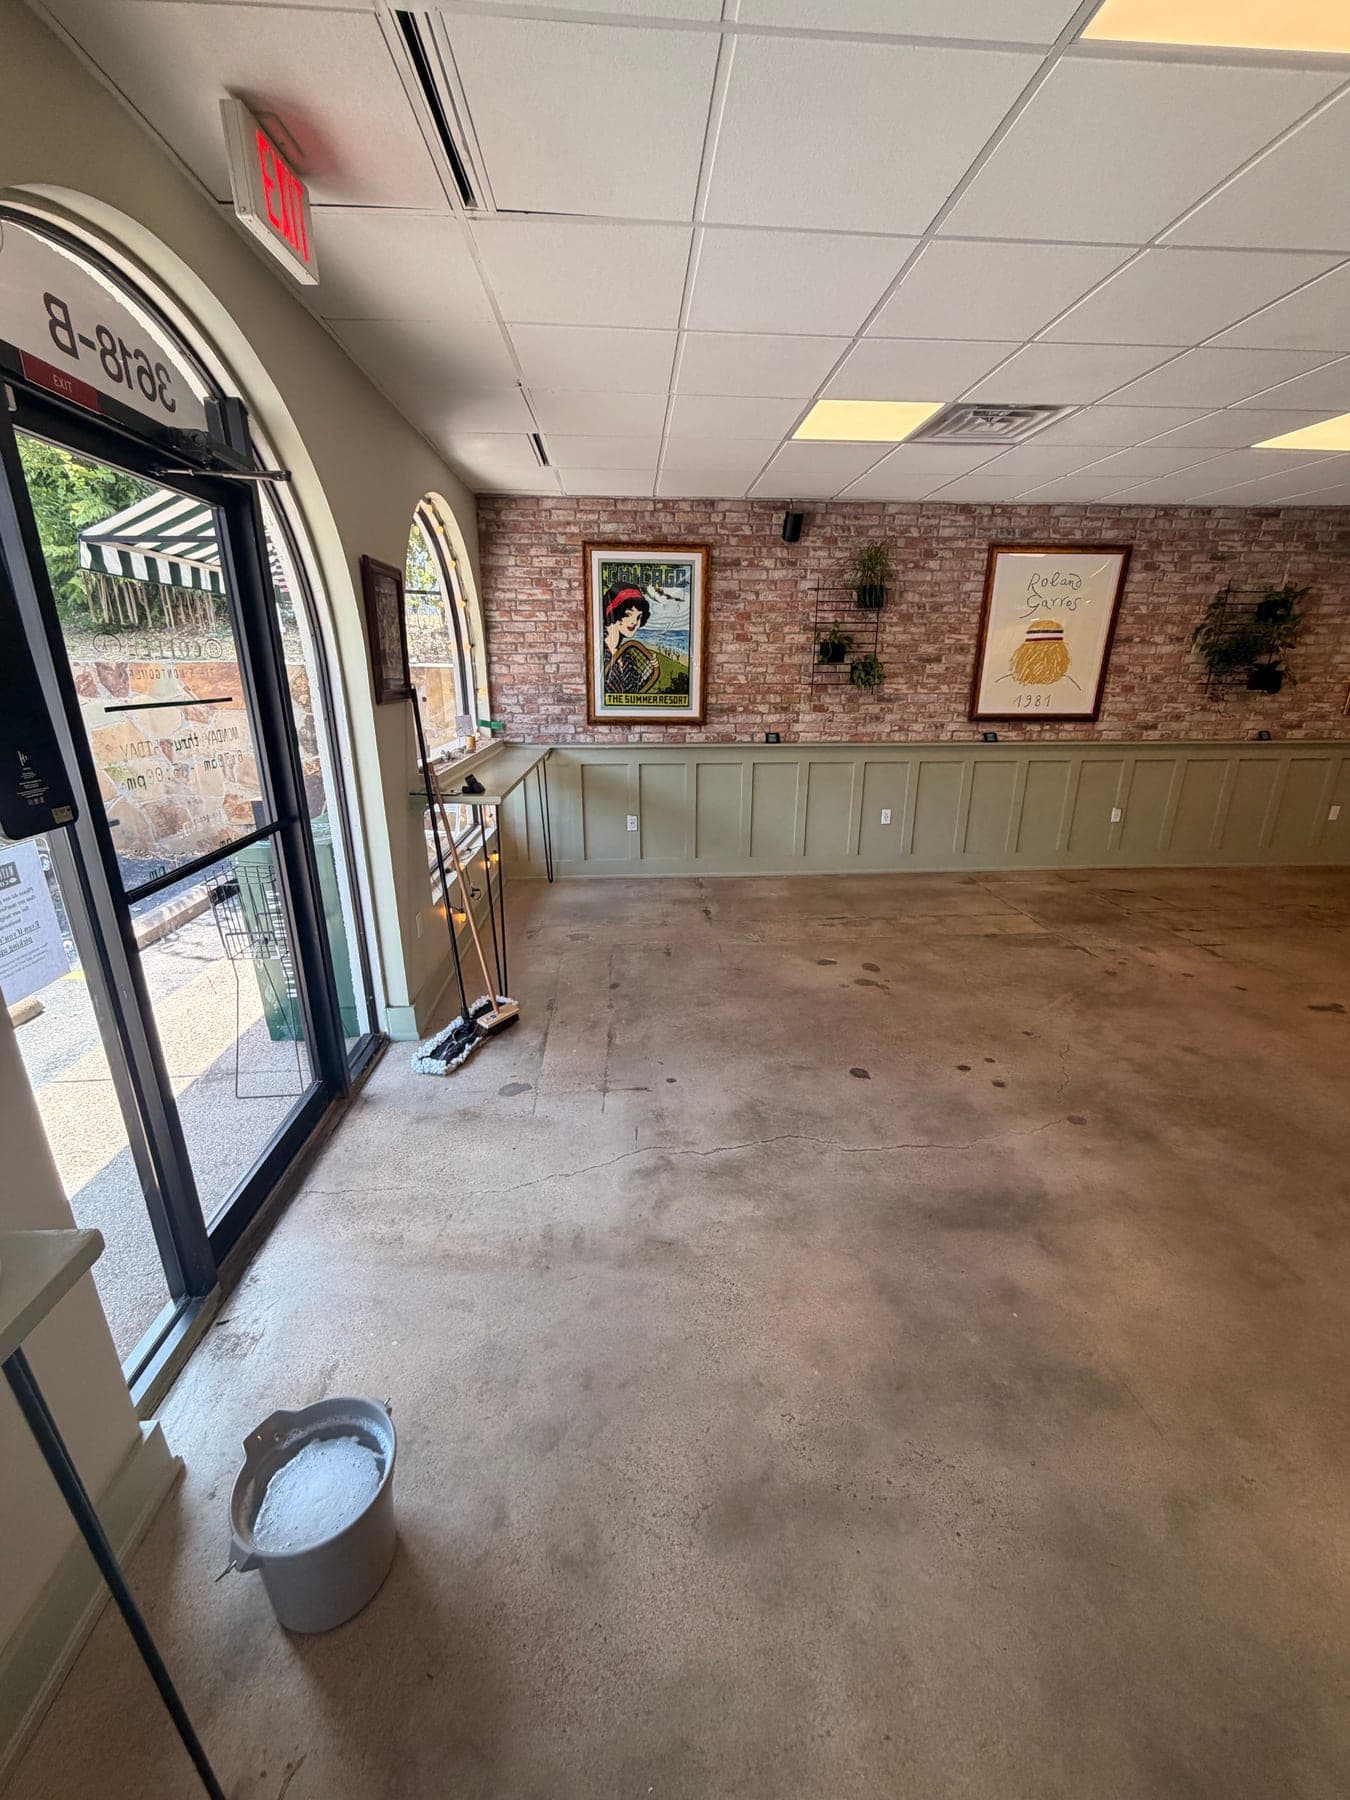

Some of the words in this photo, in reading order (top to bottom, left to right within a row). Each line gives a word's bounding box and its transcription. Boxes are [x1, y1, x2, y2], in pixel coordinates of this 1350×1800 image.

[255, 128, 310, 263] EXIT
[52, 373, 73, 393] EXIT
[608, 565, 687, 588] CHICAGO
[1026, 571, 1082, 598] Roland
[1019, 595, 1082, 619] Garros
[608, 694, 624, 704] THE
[624, 695, 658, 705] SUMMER
[659, 695, 688, 705] RESORT
[1013, 694, 1052, 708] 1981
